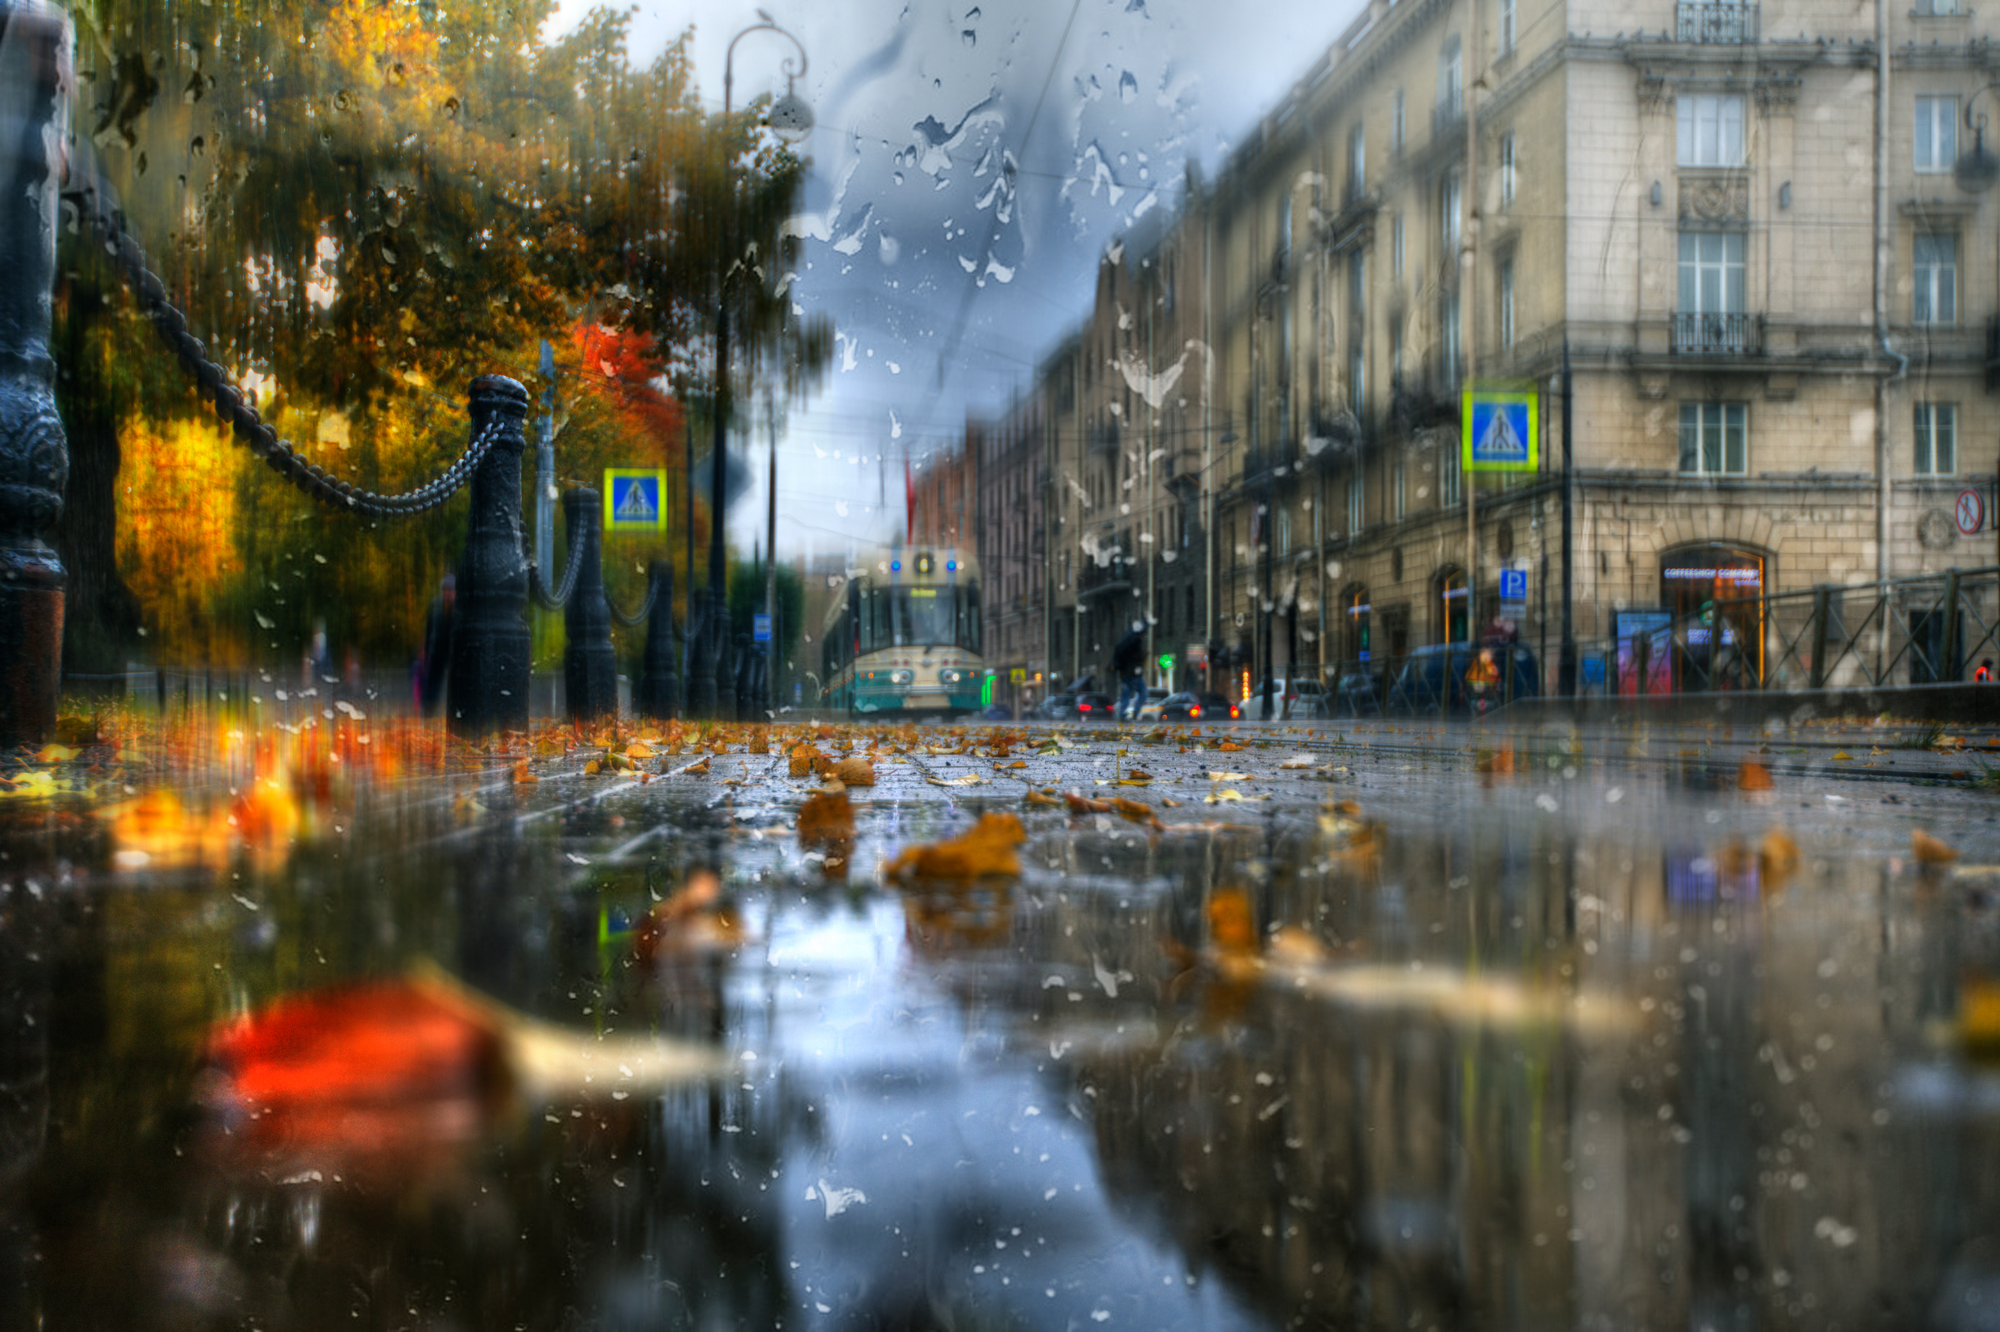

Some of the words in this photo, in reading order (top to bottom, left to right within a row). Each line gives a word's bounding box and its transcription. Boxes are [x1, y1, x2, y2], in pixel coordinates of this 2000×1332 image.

[1664, 568, 1717, 579] COFFEESHOP
[1718, 568, 1759, 579] COMPANY
[1507, 572, 1522, 595] P
